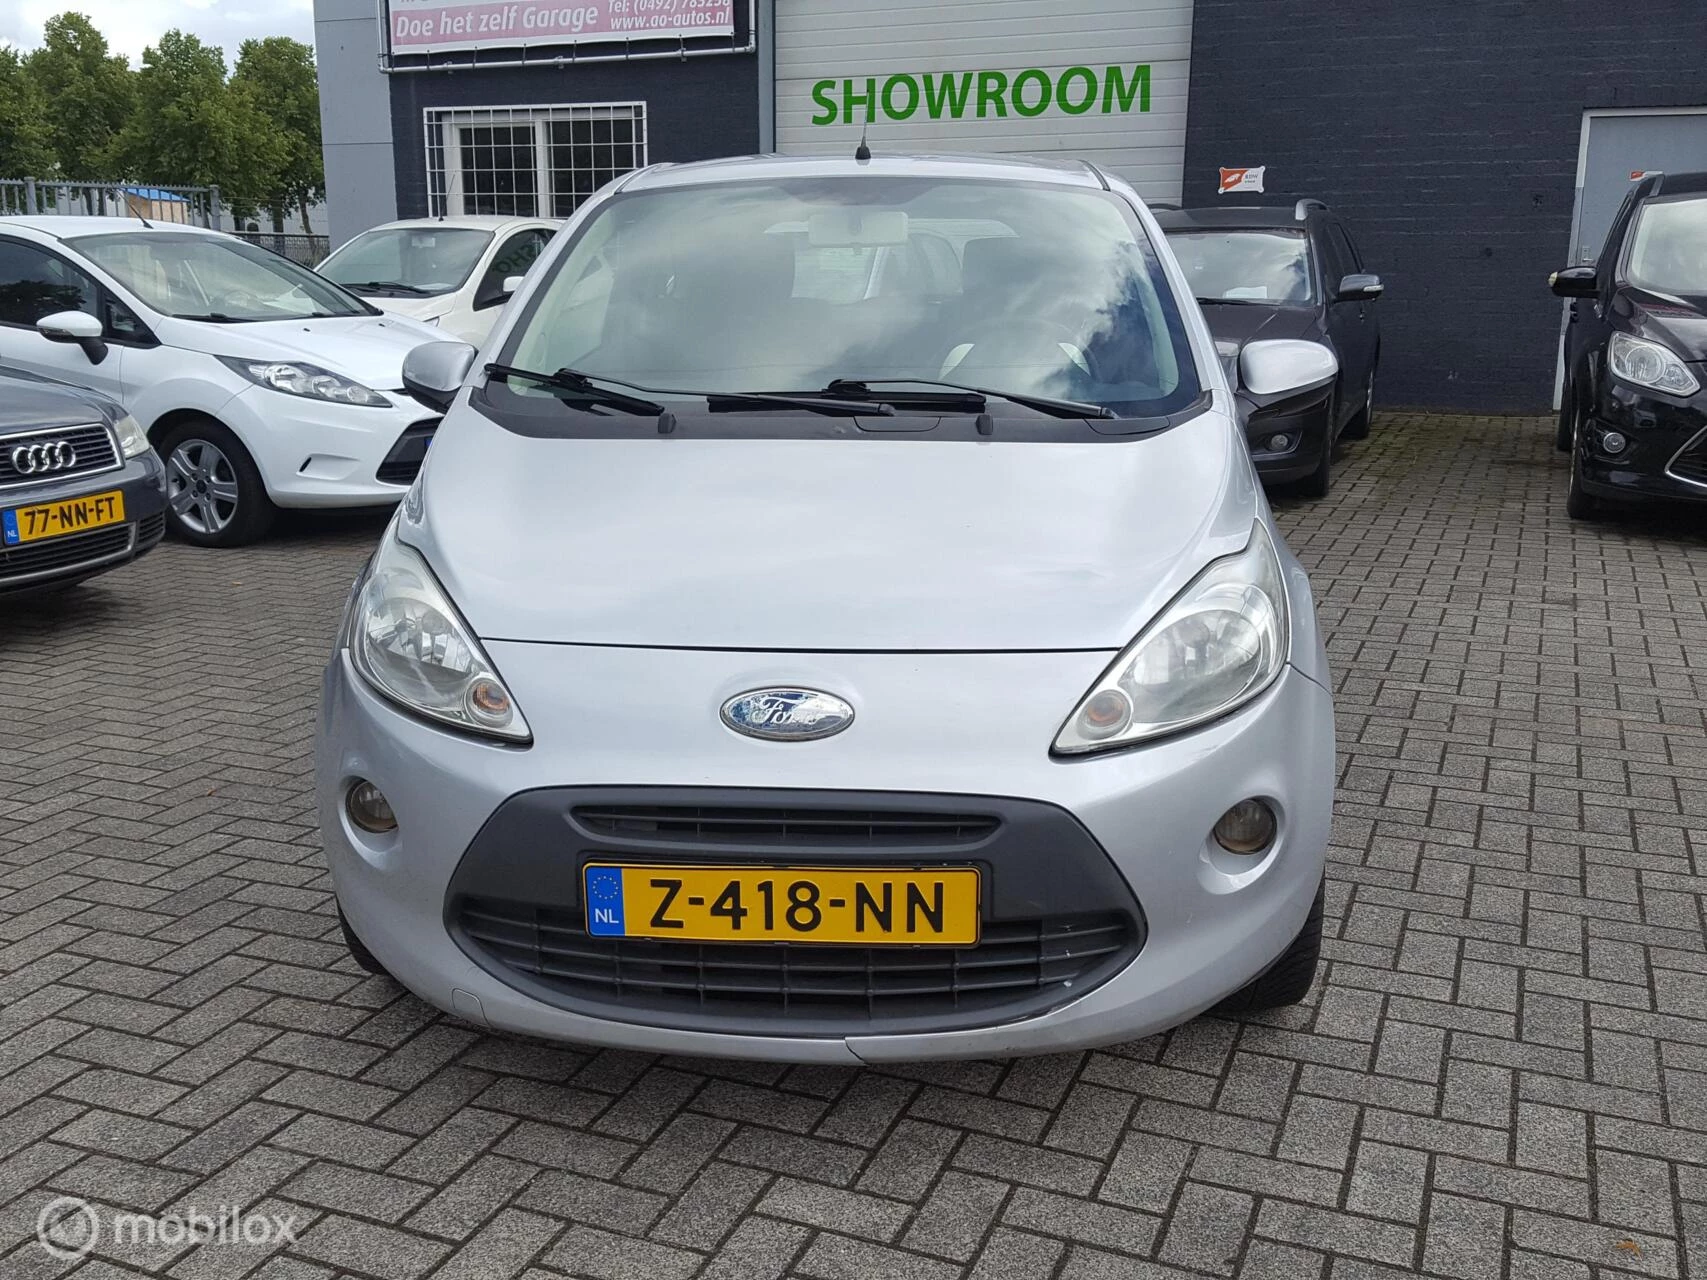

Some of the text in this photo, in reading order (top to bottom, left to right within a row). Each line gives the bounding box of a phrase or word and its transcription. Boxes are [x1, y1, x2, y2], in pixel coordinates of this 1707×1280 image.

[396, 5, 598, 37] Doe het zelf Garage
[608, 0, 629, 13] Tel:
[634, 0, 677, 15] (0492)
[610, 7, 729, 30] www.ao-autos.nl
[811, 64, 1151, 126] SHOWROOM
[24, 496, 115, 535] 77-NN-FT
[7, 530, 17, 538] NL
[595, 907, 619, 924] NL
[649, 878, 945, 933] Z-418-NN
